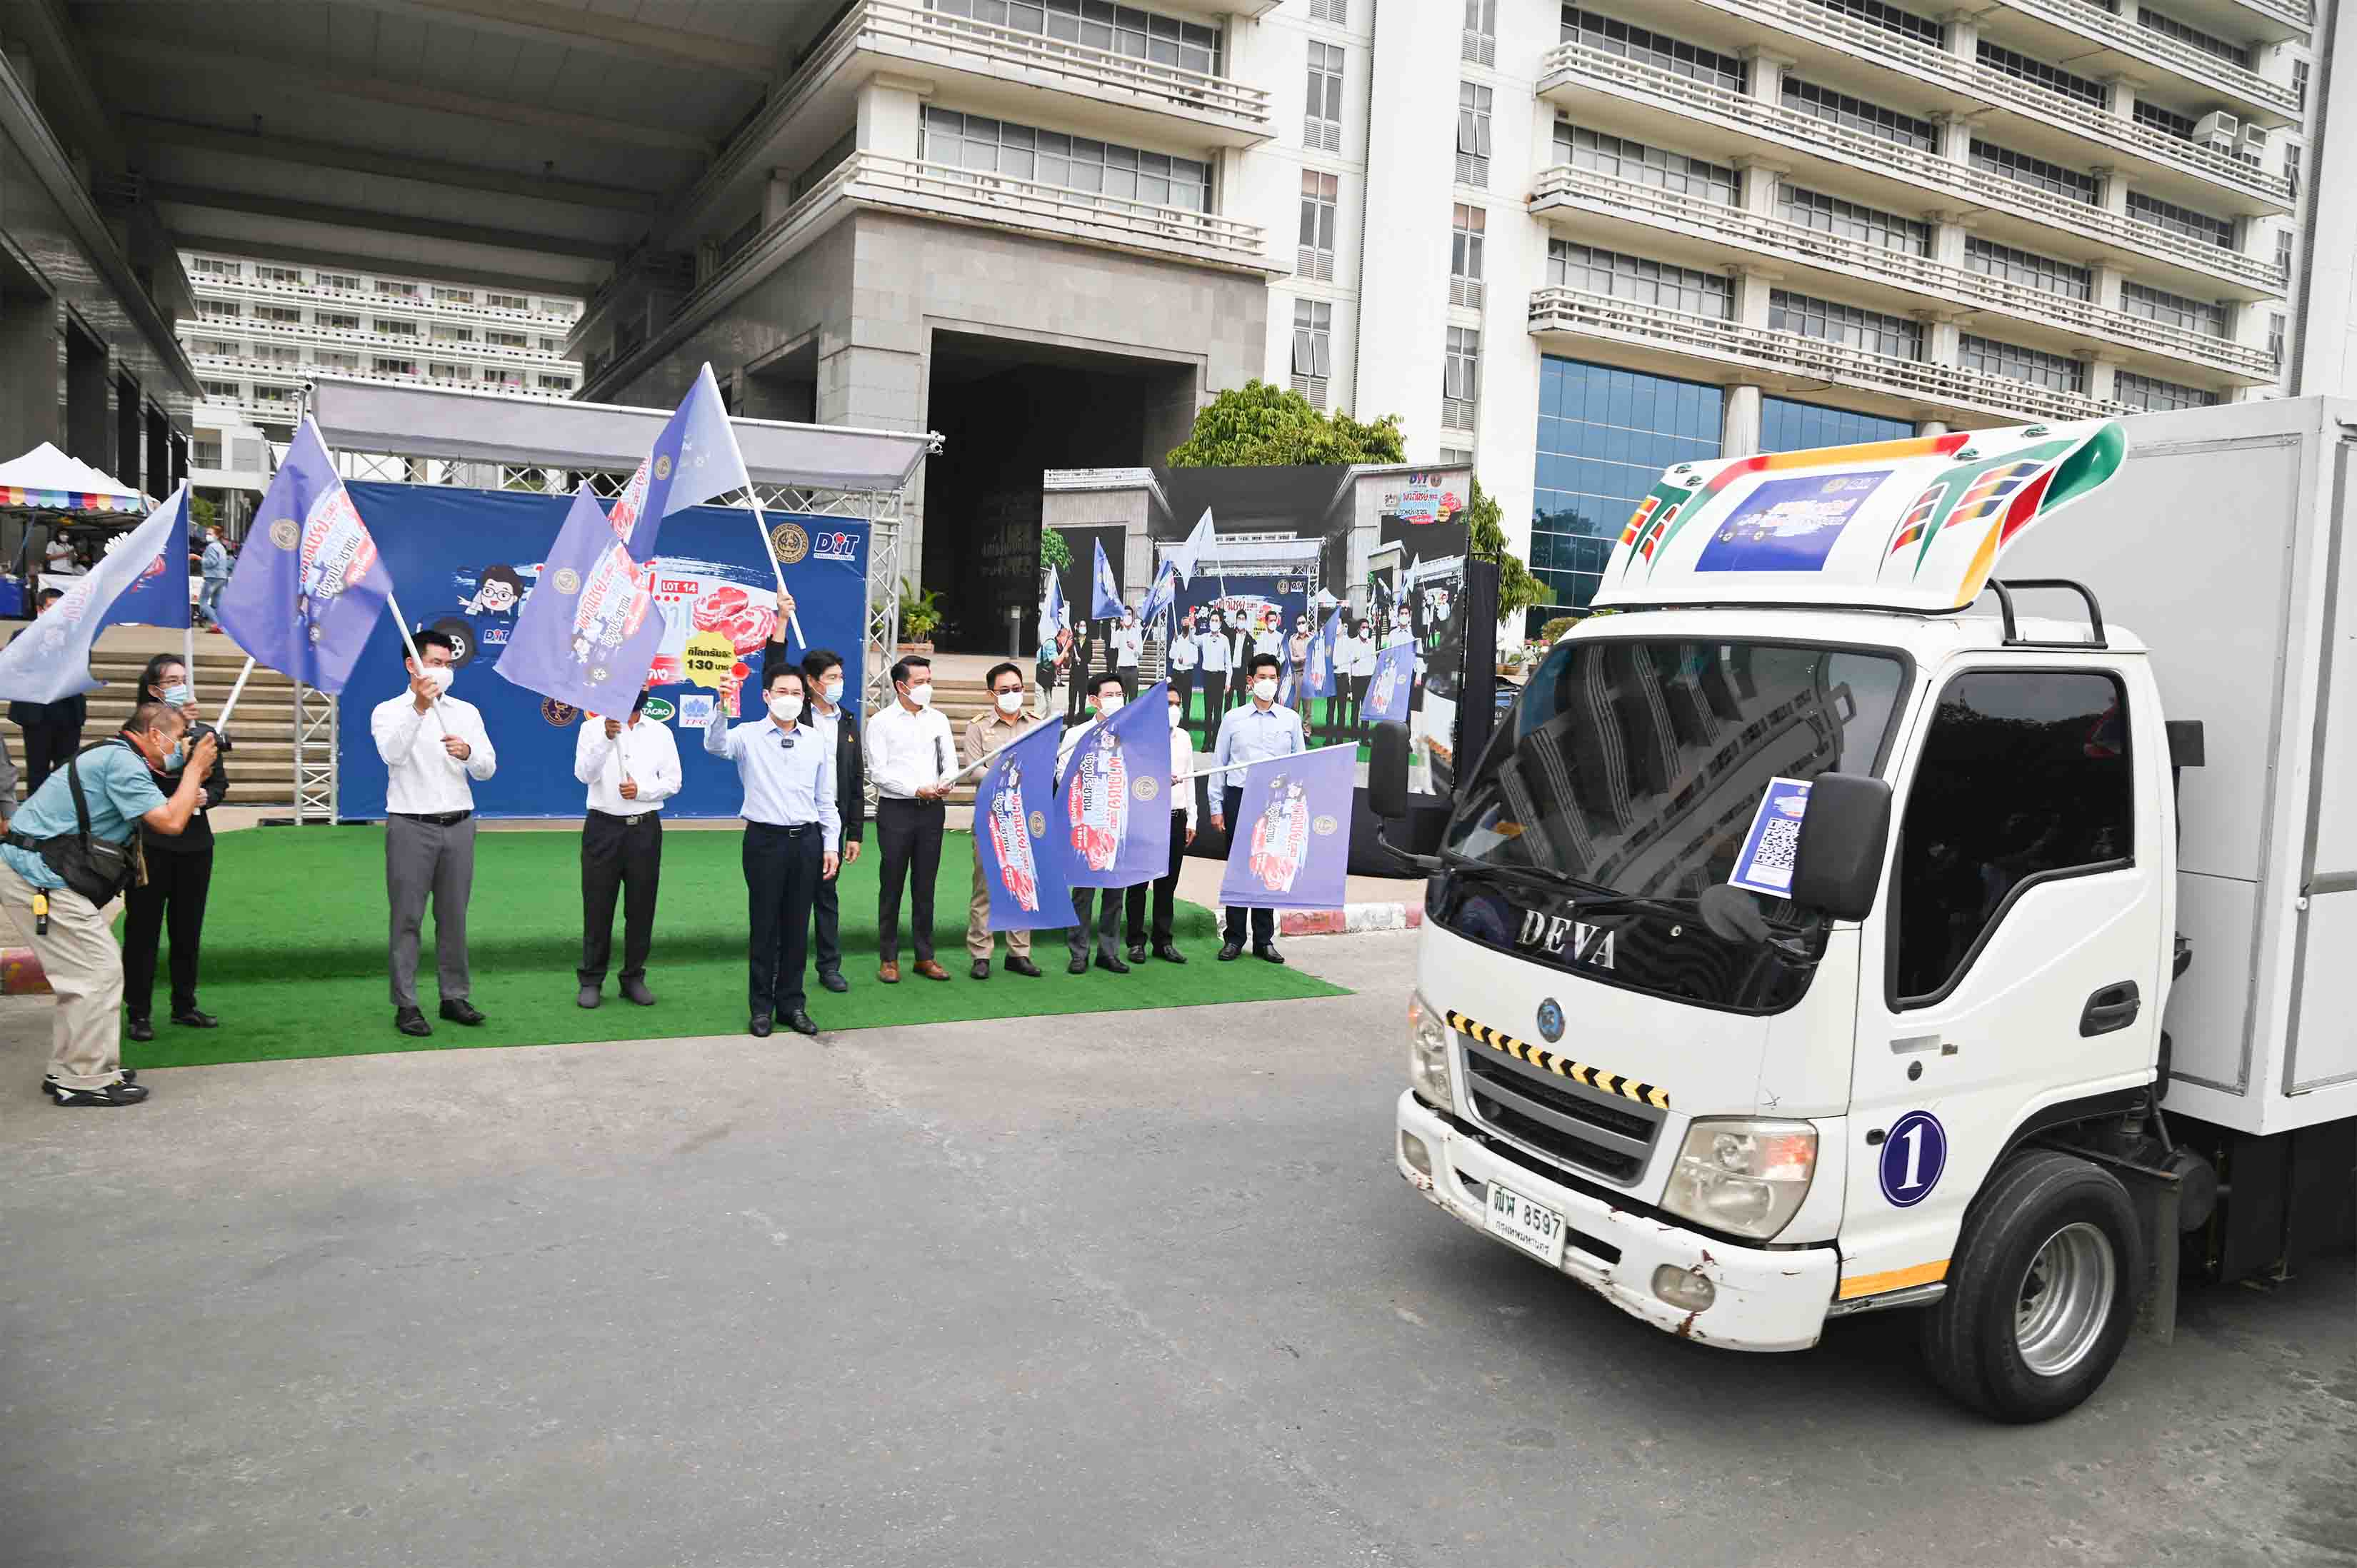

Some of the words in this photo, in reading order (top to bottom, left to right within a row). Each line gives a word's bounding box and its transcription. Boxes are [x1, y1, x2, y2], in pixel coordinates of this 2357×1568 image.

[662, 581, 679, 591] LOT
[683, 583, 698, 593] 14
[687, 659, 714, 670] 130
[1515, 910, 1615, 969] DEVA
[1897, 1123, 1923, 1189] 1
[1524, 1205, 1560, 1240] 8597
